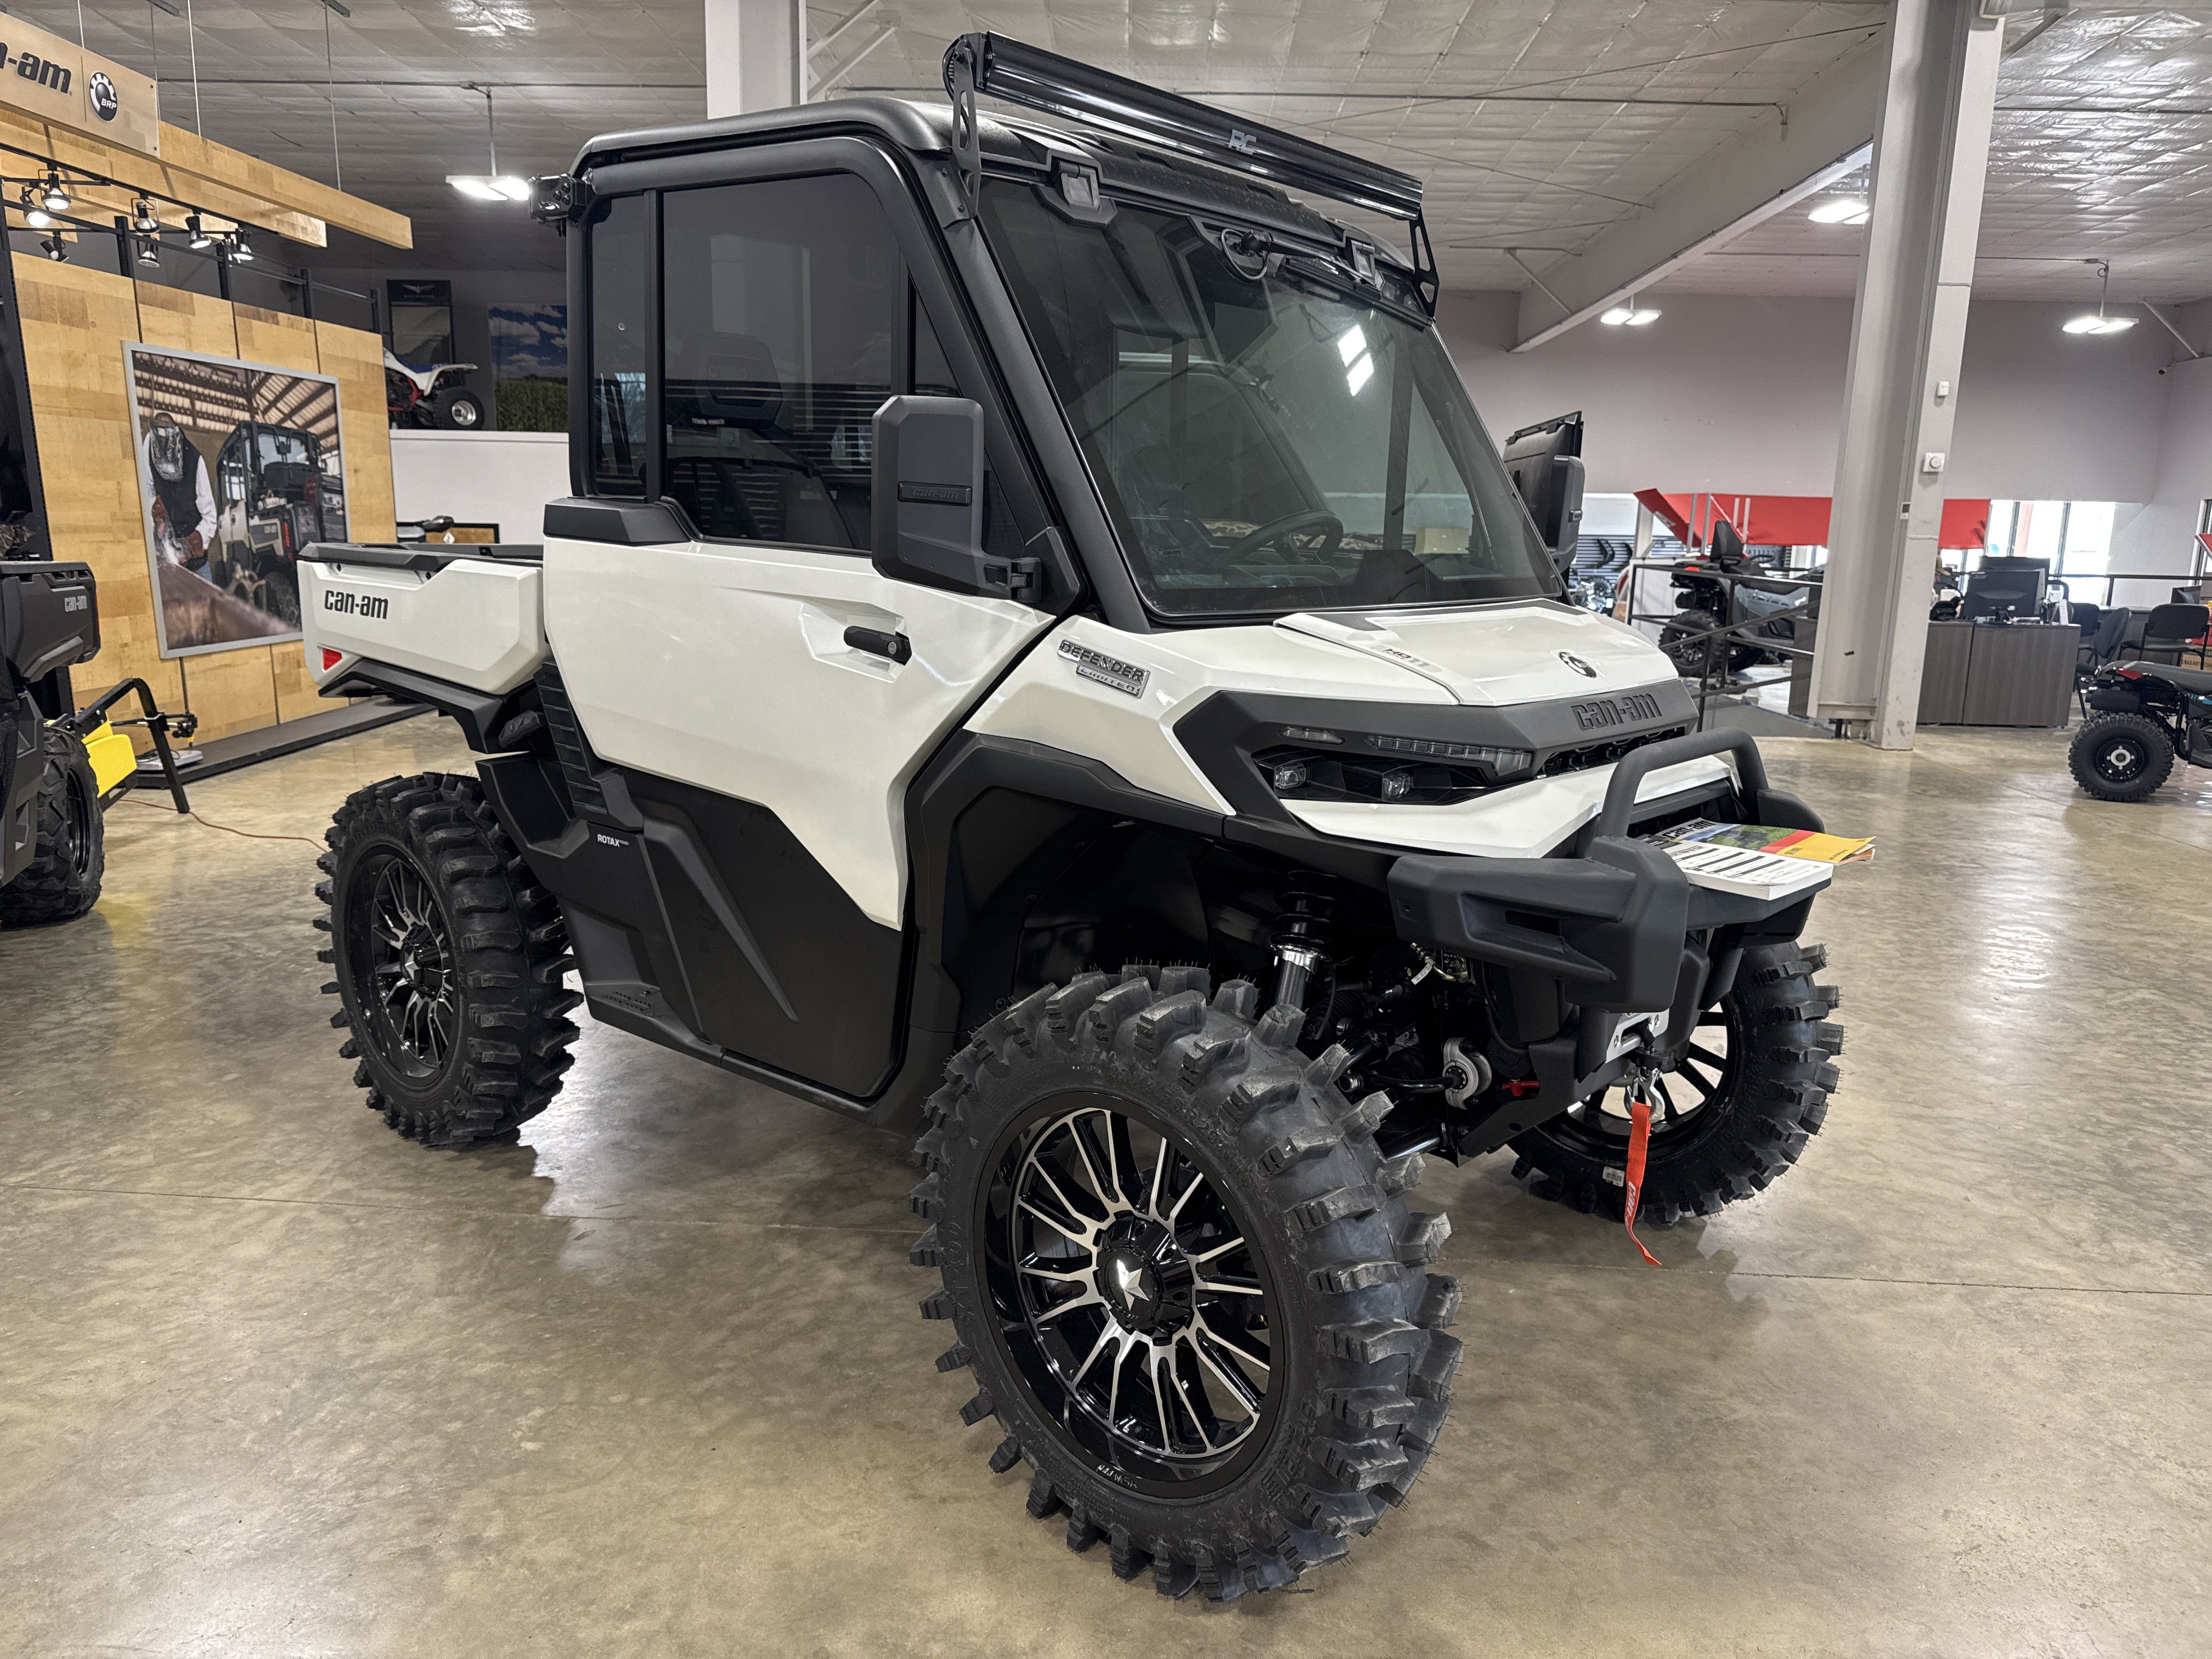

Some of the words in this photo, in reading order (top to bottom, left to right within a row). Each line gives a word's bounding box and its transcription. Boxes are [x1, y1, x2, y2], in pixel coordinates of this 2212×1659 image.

[101, 98, 117, 109] BRP
[912, 489, 959, 499] can-am
[64, 595, 87, 612] can-am
[324, 590, 388, 619] can-am
[1060, 642, 1144, 682] DEFENDER
[1571, 693, 1662, 731] can-am
[1662, 820, 1716, 839] can-am
[597, 833, 620, 848] ROTAX
